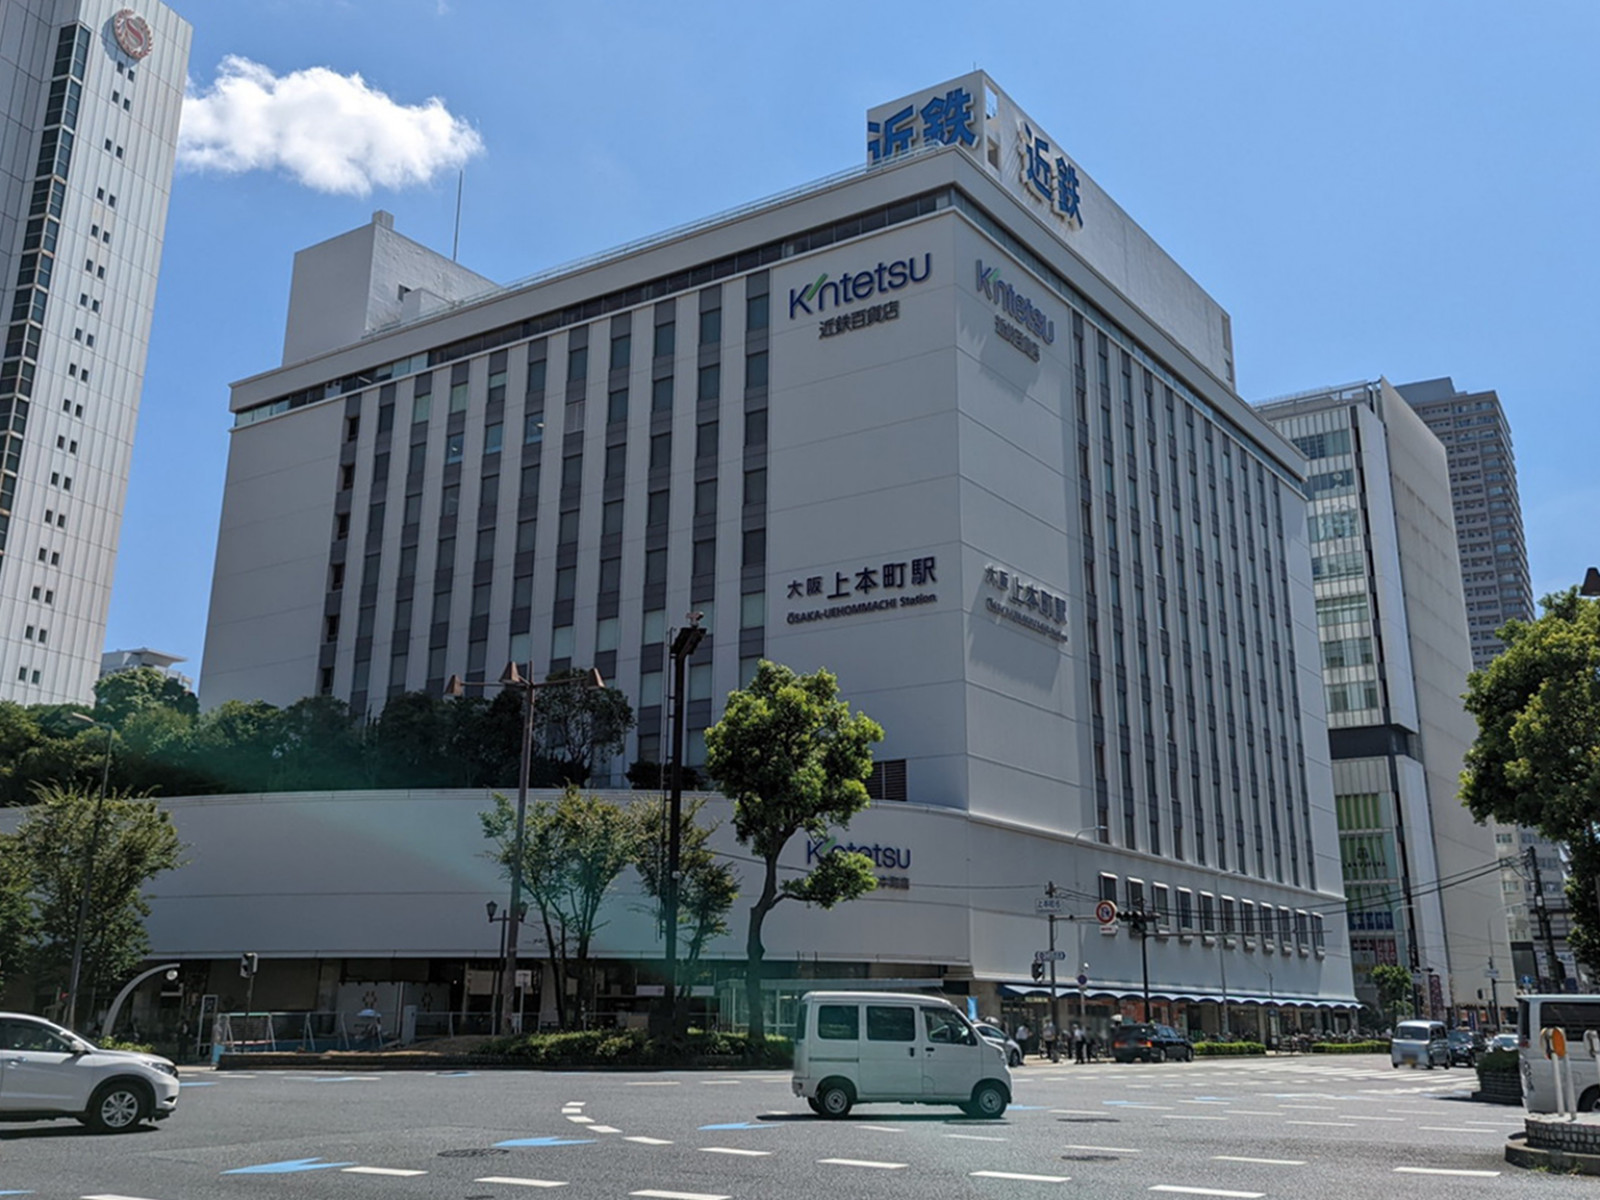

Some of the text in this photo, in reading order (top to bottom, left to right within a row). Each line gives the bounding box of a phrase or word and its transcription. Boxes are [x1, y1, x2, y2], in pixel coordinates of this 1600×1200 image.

[868, 86, 976, 161] 近鉄
[1022, 121, 1084, 229] 近鉄
[789, 252, 931, 320] Kintetsu
[818, 300, 900, 340] 近鉄百貨店
[976, 258, 1054, 345] Kintetsu
[899, 593, 937, 607] Station
